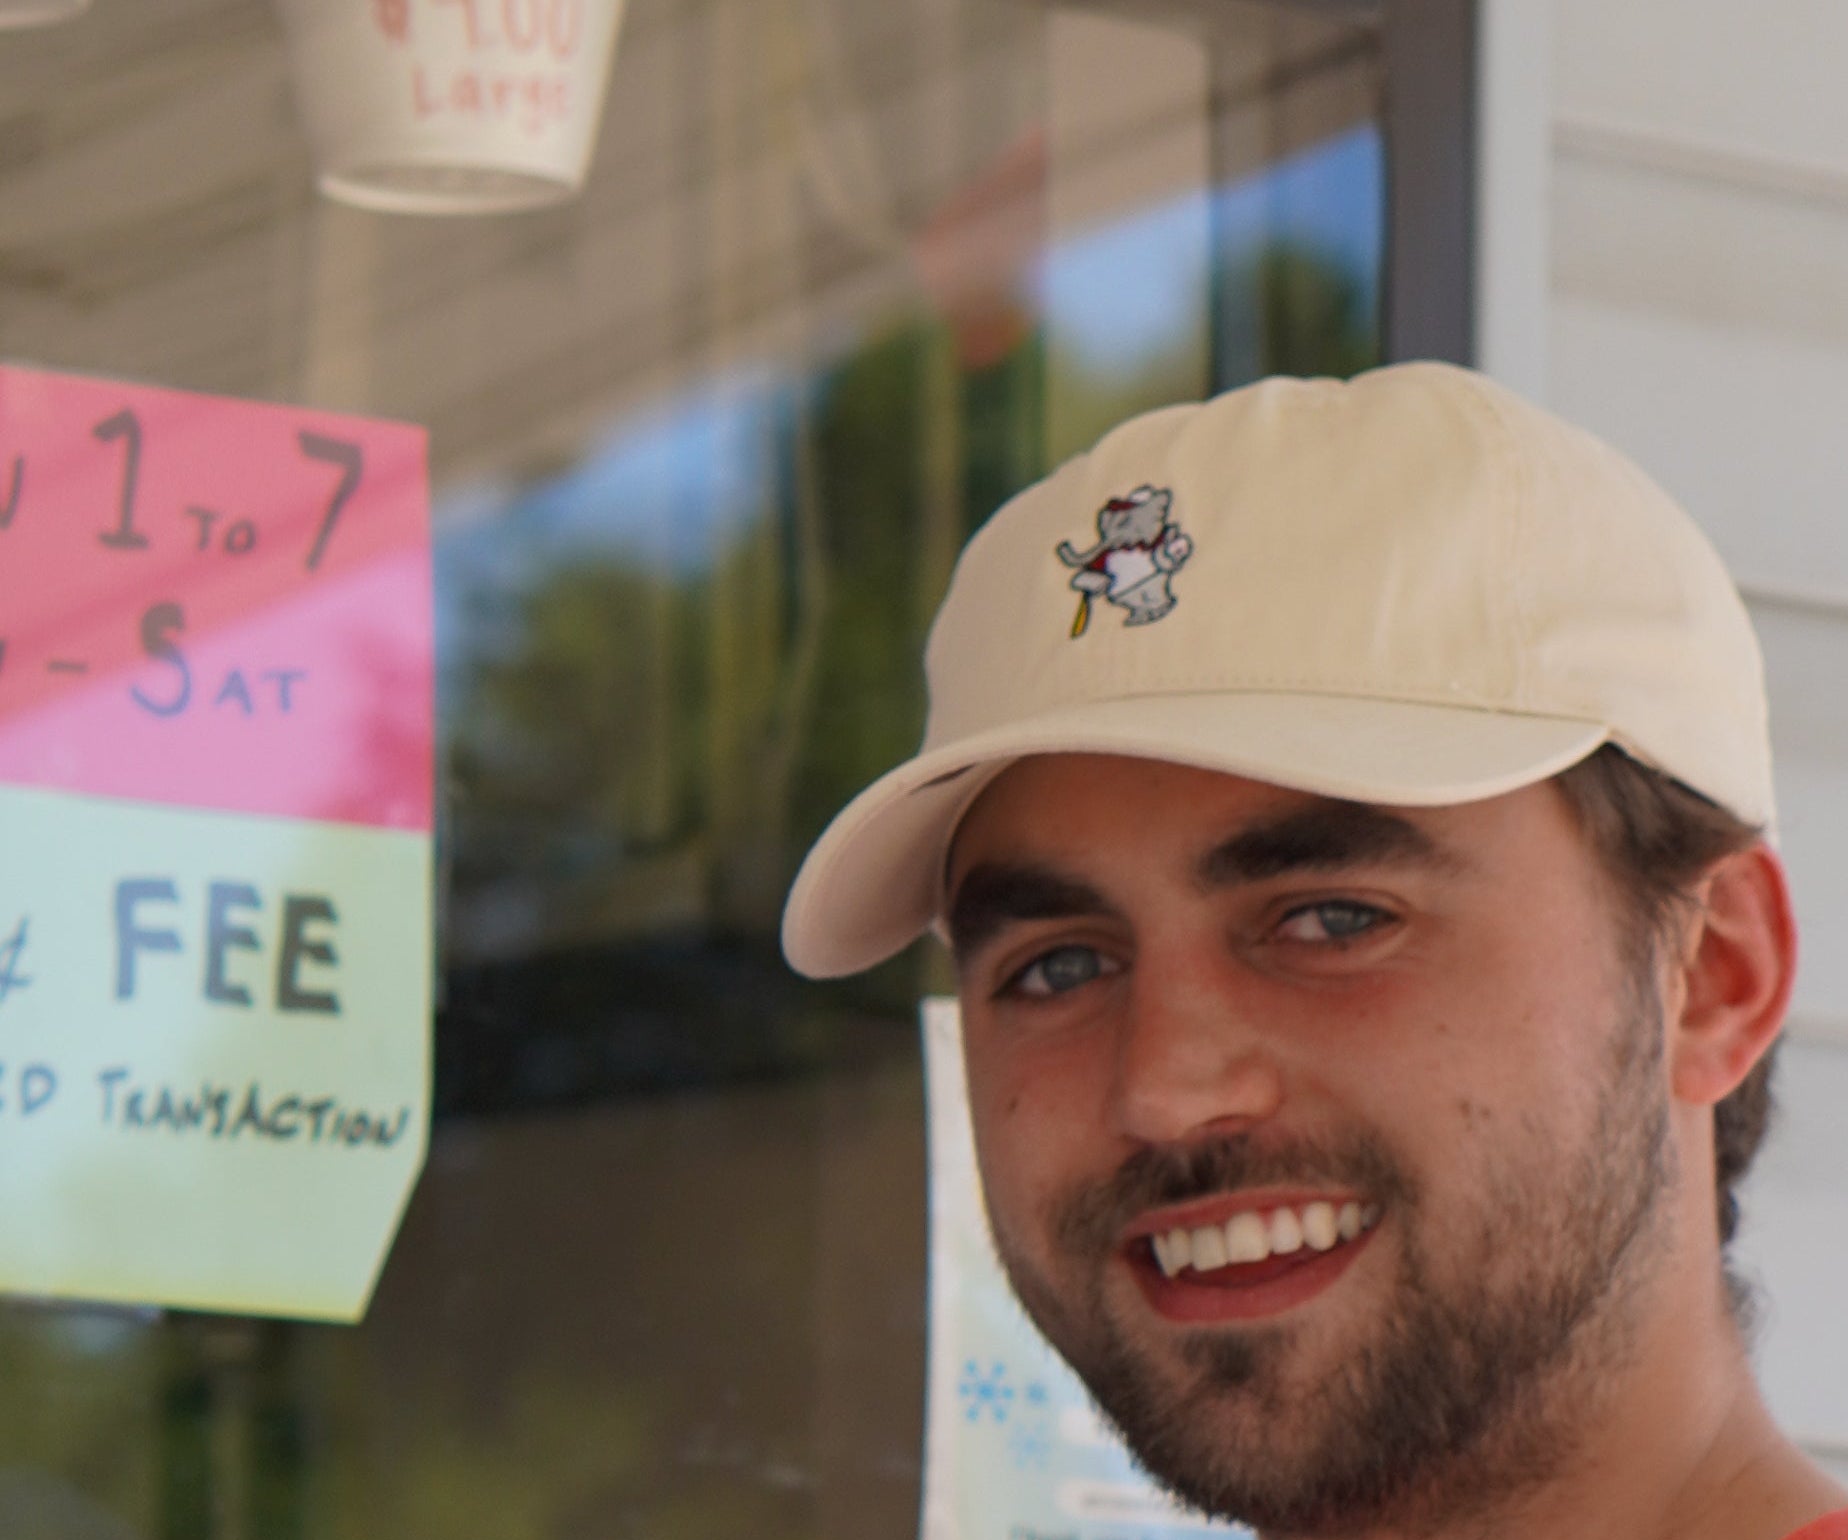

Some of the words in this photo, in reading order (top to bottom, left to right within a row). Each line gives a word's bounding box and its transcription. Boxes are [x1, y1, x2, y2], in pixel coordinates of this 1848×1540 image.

[93, 408, 149, 549] 1
[297, 428, 363, 570] 7
[114, 877, 342, 1015] FEE
